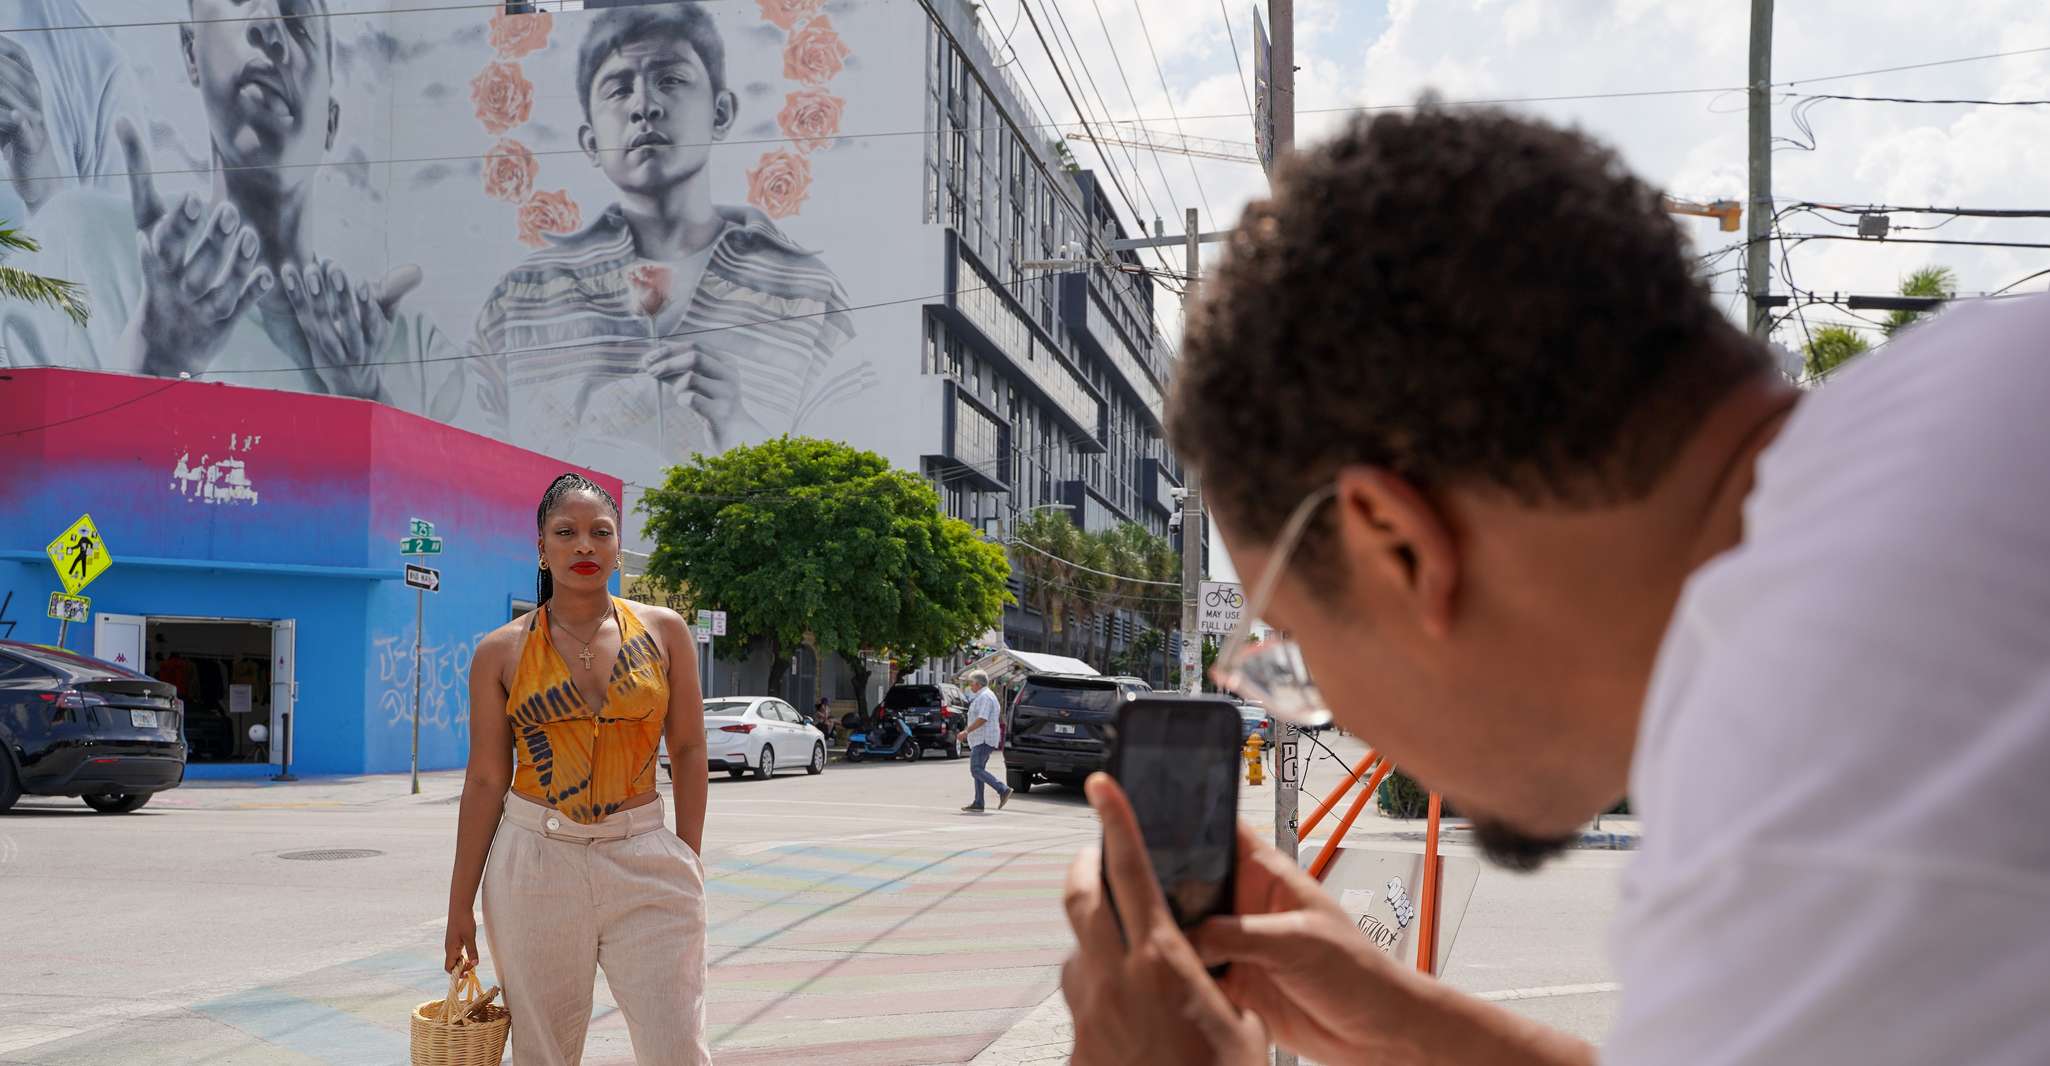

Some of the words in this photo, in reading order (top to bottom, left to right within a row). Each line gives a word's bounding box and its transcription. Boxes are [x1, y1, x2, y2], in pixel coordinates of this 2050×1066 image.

[416, 539, 423, 552] 2
[1206, 610, 1222, 618] MAY
[1225, 611, 1241, 620] USE
[1201, 621, 1220, 630] FULL
[1224, 622, 1239, 631] LAN
